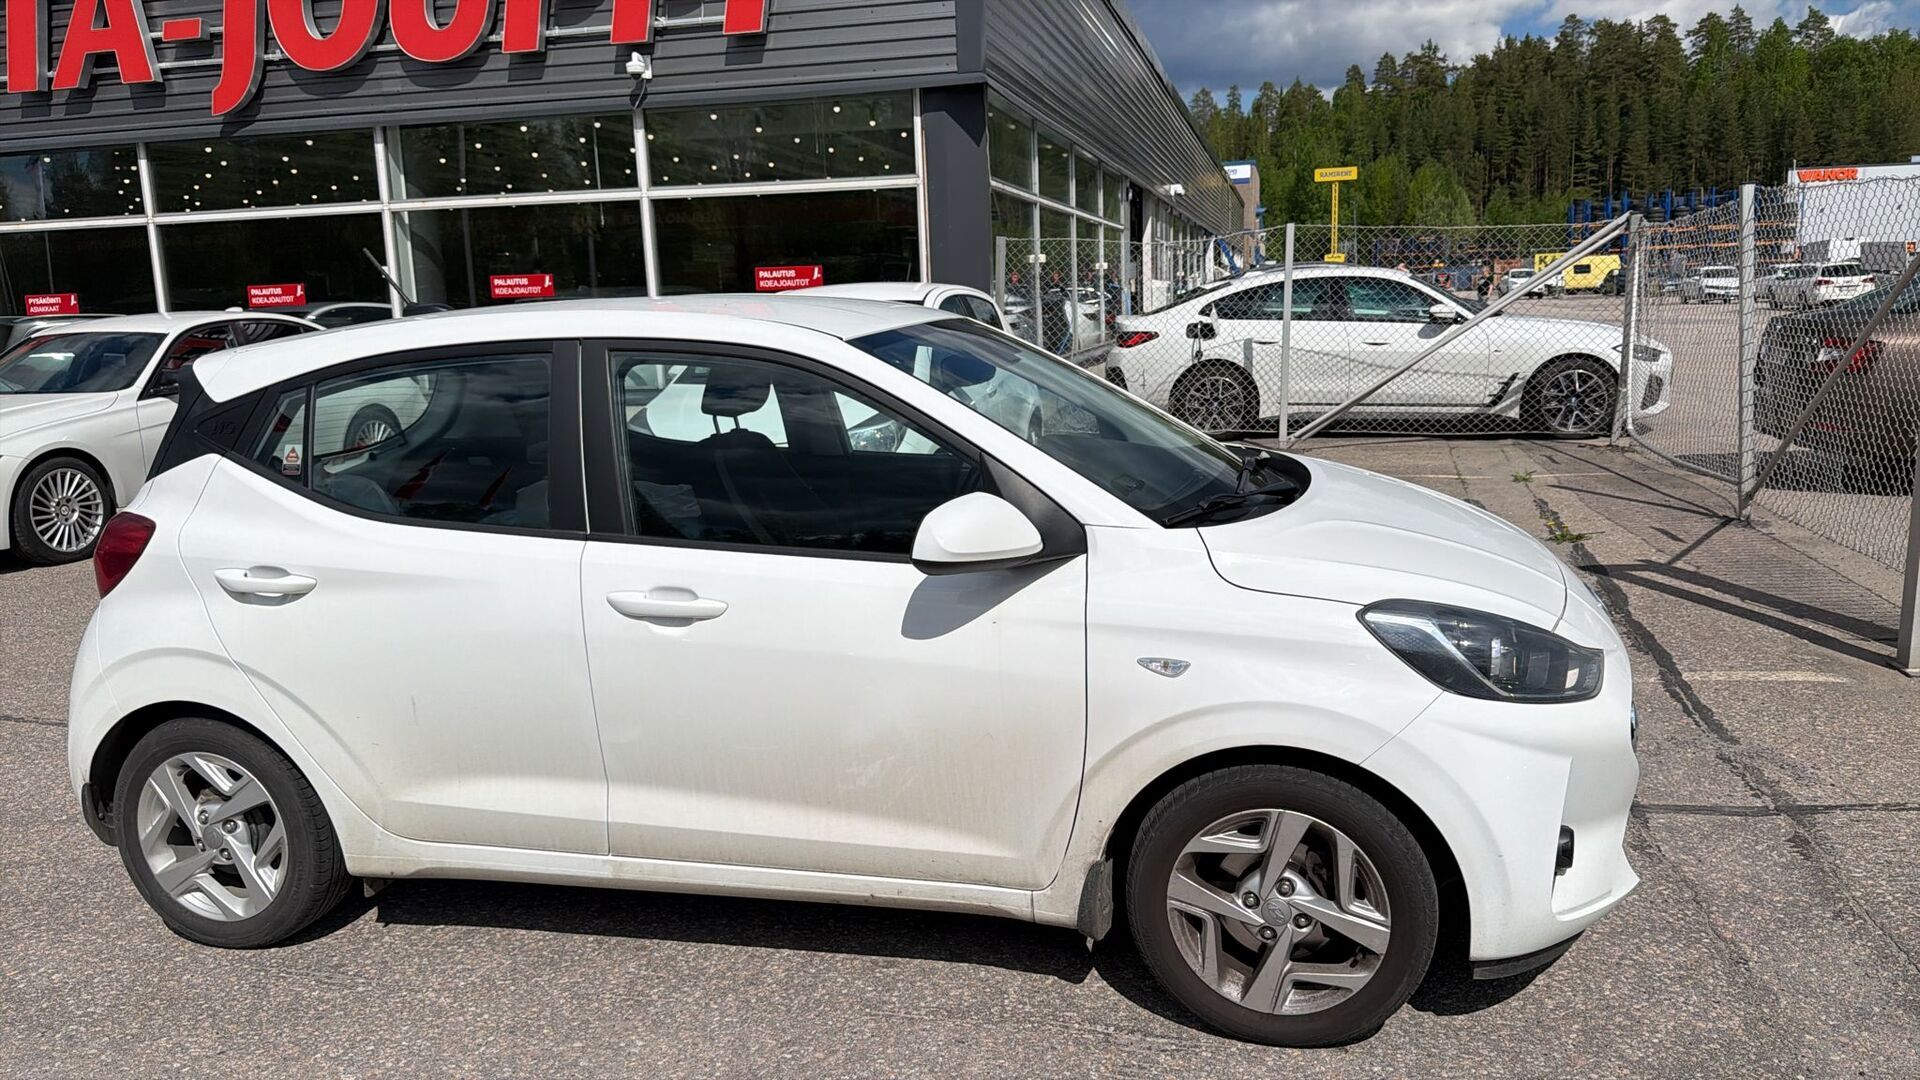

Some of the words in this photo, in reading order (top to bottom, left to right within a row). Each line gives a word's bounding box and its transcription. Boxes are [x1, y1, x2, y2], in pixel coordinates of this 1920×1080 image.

[758, 269, 796, 278] PALAUTUS
[494, 277, 529, 286] PALAUTUS
[759, 278, 810, 287] KOEAJOAUTOT
[250, 287, 283, 296] PALAUTUS
[494, 286, 542, 295] KOEAJOAUTOT
[251, 295, 295, 304] KOEAJOAUTOT
[29, 304, 60, 313] ASIAKKAAT
